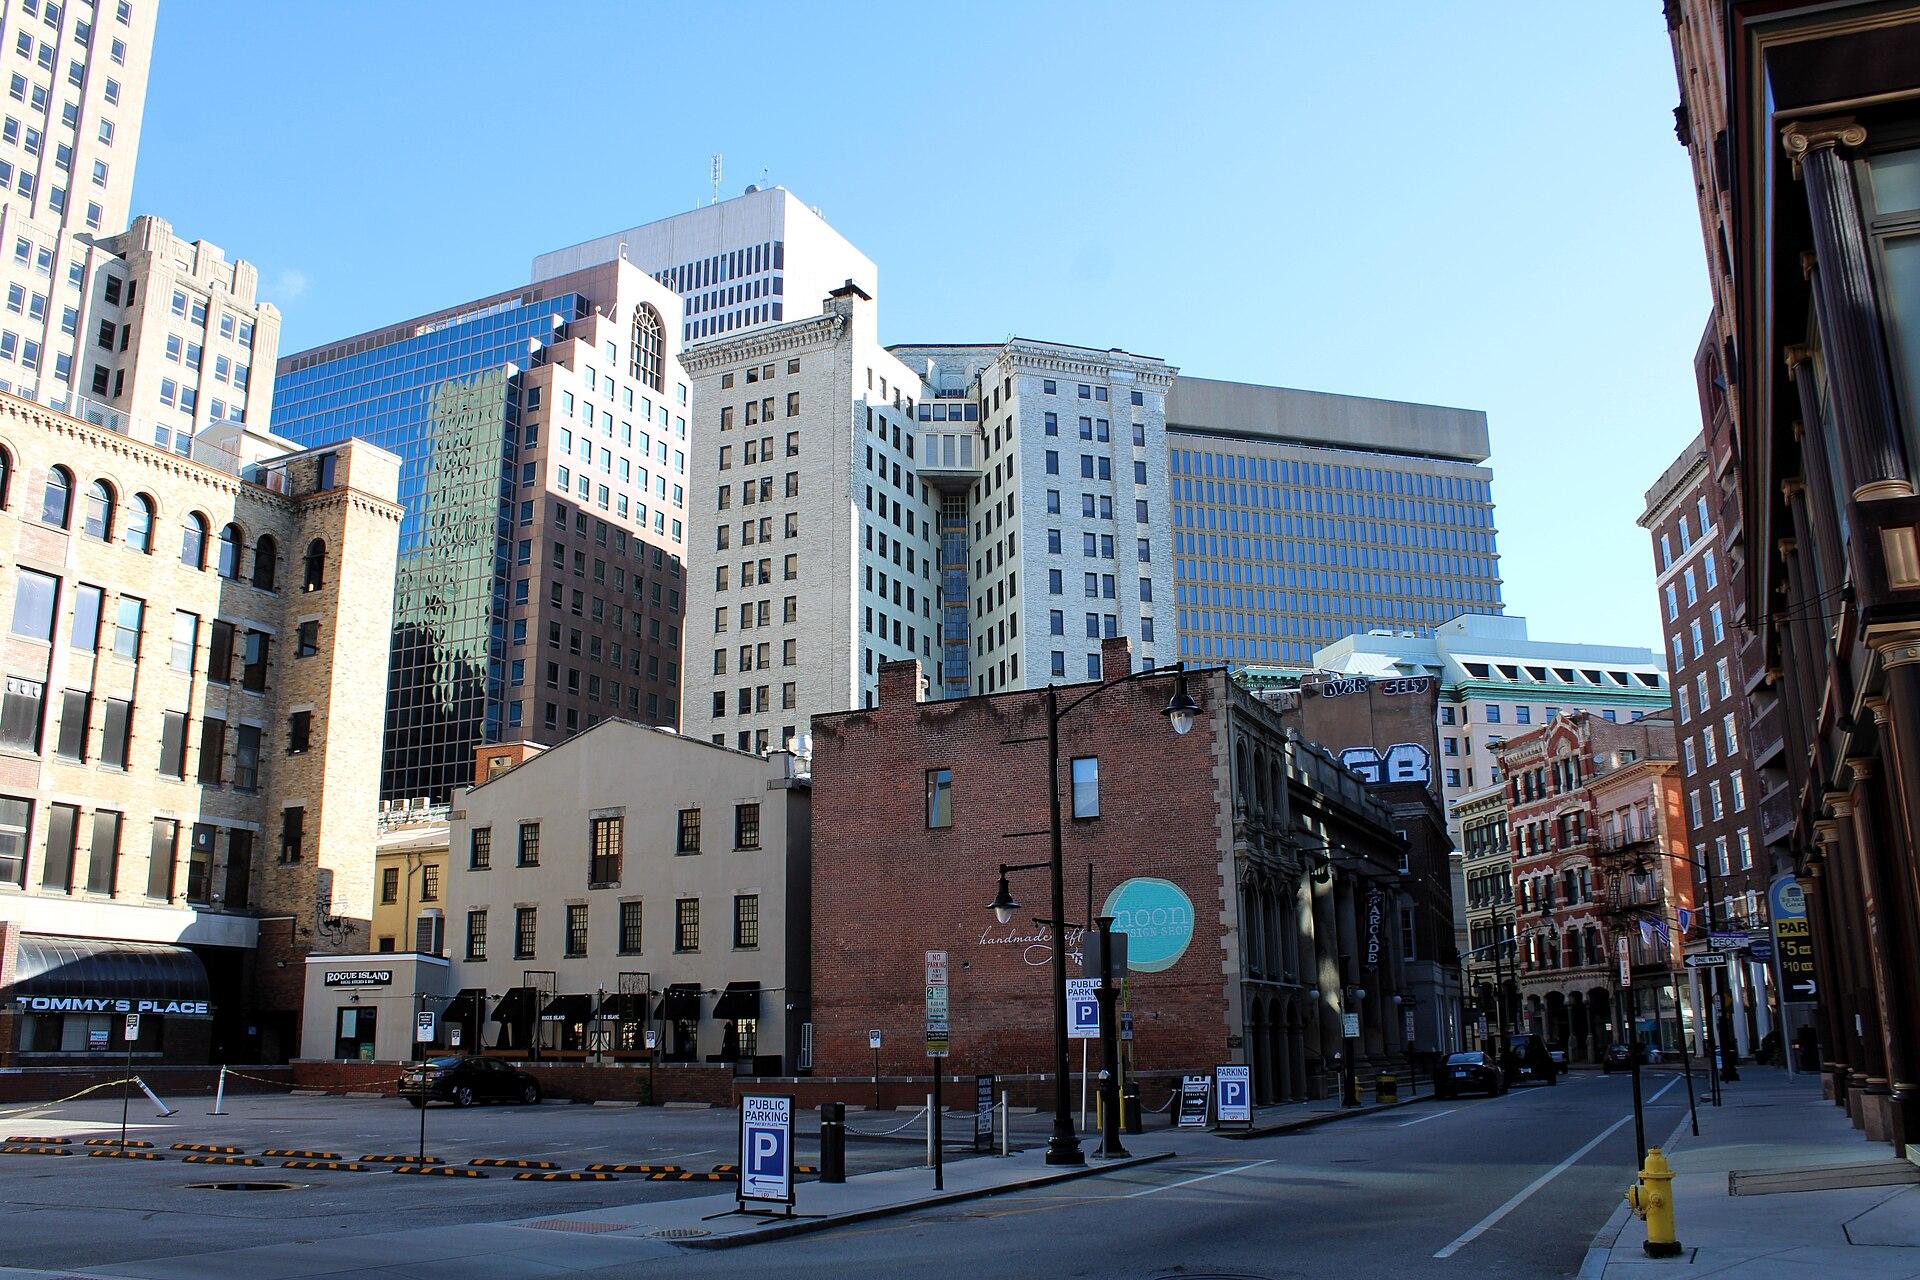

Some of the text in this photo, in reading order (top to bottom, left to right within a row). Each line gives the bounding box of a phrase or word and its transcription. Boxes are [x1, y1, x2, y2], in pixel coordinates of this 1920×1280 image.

[1113, 907, 1188, 928] noon
[1115, 926, 1190, 938] SIGN SHOP
[1368, 905, 1380, 962] ARCADE
[1778, 922, 1808, 933] PAR
[979, 926, 1052, 945] handmade
[1713, 937, 1737, 946] PECK
[326, 971, 389, 983] ROGUE ISLAND
[1071, 980, 1102, 988] PUBLIC
[927, 987, 933, 998] 2
[1067, 988, 1093, 996] PARKI
[16, 996, 208, 1014] TOMMY'S PLACE
[1081, 1005, 1093, 1021] P
[1217, 1067, 1248, 1077] PARKING
[1227, 1083, 1240, 1104] P
[749, 1099, 785, 1110] PUBLIC
[745, 1111, 788, 1122] PARKING
[754, 1132, 778, 1171] P
